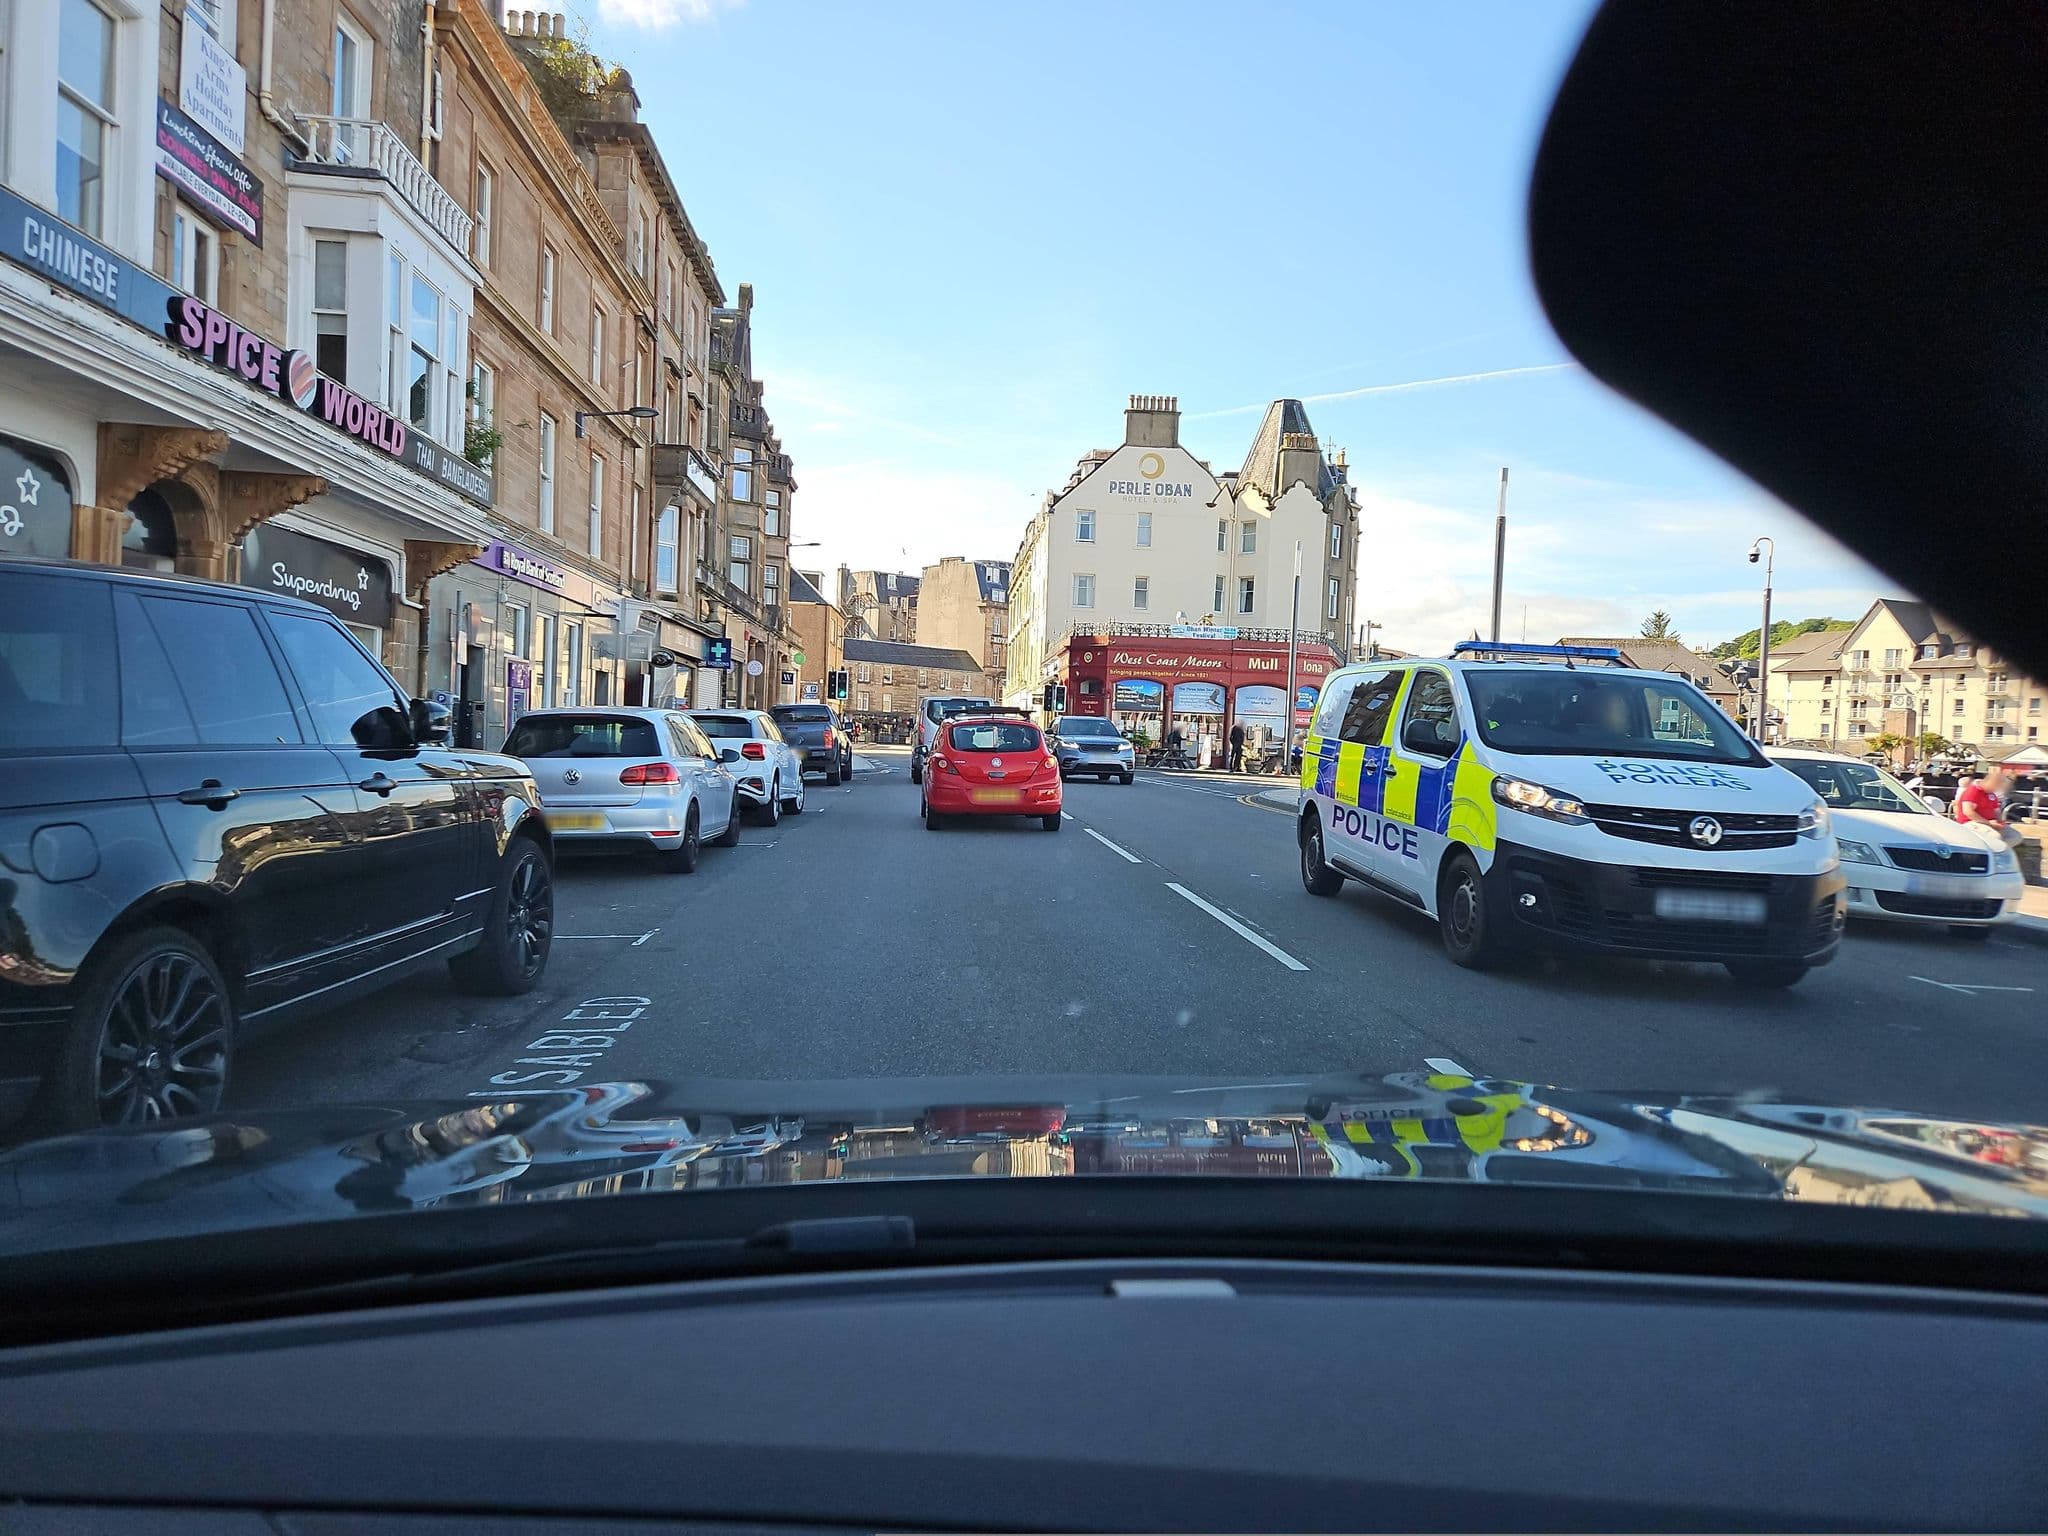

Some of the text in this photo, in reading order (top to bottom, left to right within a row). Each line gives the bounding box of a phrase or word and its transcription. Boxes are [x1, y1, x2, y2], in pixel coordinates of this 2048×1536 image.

[201, 36, 233, 79] King's
[195, 73, 233, 123] Holiday
[202, 63, 230, 97] Arms
[184, 87, 243, 146] Apartments
[162, 109, 253, 192] Lunchtime Special Offer
[162, 154, 194, 184] AVAILABLE
[194, 178, 222, 205] EVERYDAY
[211, 169, 238, 198] ONLY
[23, 216, 119, 301] CHINESE
[178, 296, 406, 457] SPICE WORLD
[415, 441, 490, 502] THAI BANGLADESHI
[1109, 480, 1192, 497] PERLE OBAN
[271, 561, 362, 612] Superdrug
[511, 552, 566, 589] Royal Bank of Scotland
[1113, 652, 1223, 669] West Coast Motors
[1248, 657, 1279, 670] Mull
[1303, 660, 1323, 673] Iona
[1594, 761, 1734, 780] POLICE
[1608, 774, 1752, 792] POILEAS
[1330, 803, 1420, 861] POLICE
